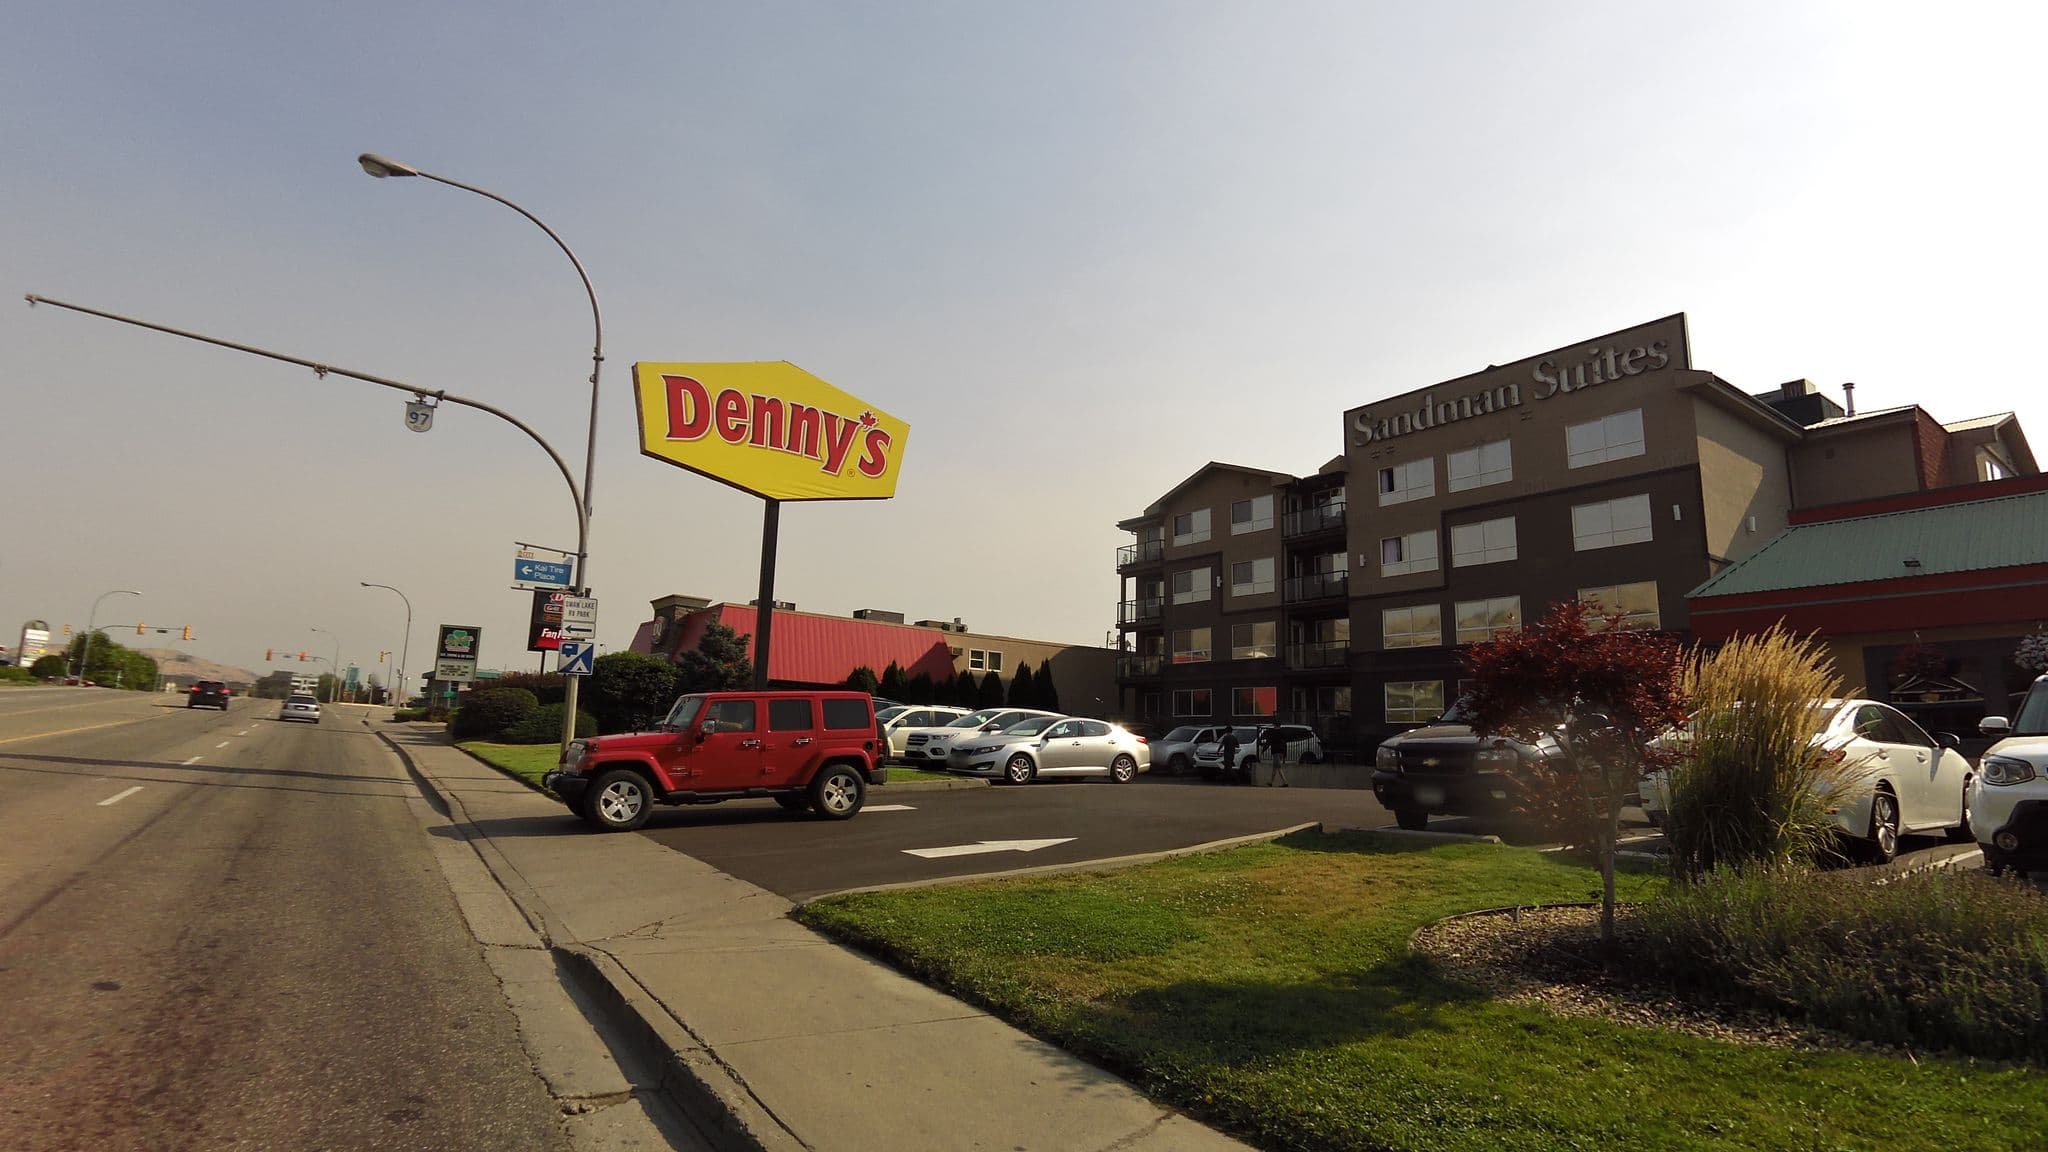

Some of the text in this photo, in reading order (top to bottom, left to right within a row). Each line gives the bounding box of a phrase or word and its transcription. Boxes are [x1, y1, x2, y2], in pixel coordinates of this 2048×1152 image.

[1353, 337, 1670, 448] Sandman Suites
[409, 411, 430, 425] 97
[660, 374, 893, 478] Denny's
[549, 565, 564, 574] Tire
[534, 572, 555, 580] Place
[581, 602, 595, 610] LAKE
[576, 610, 590, 618] PARK
